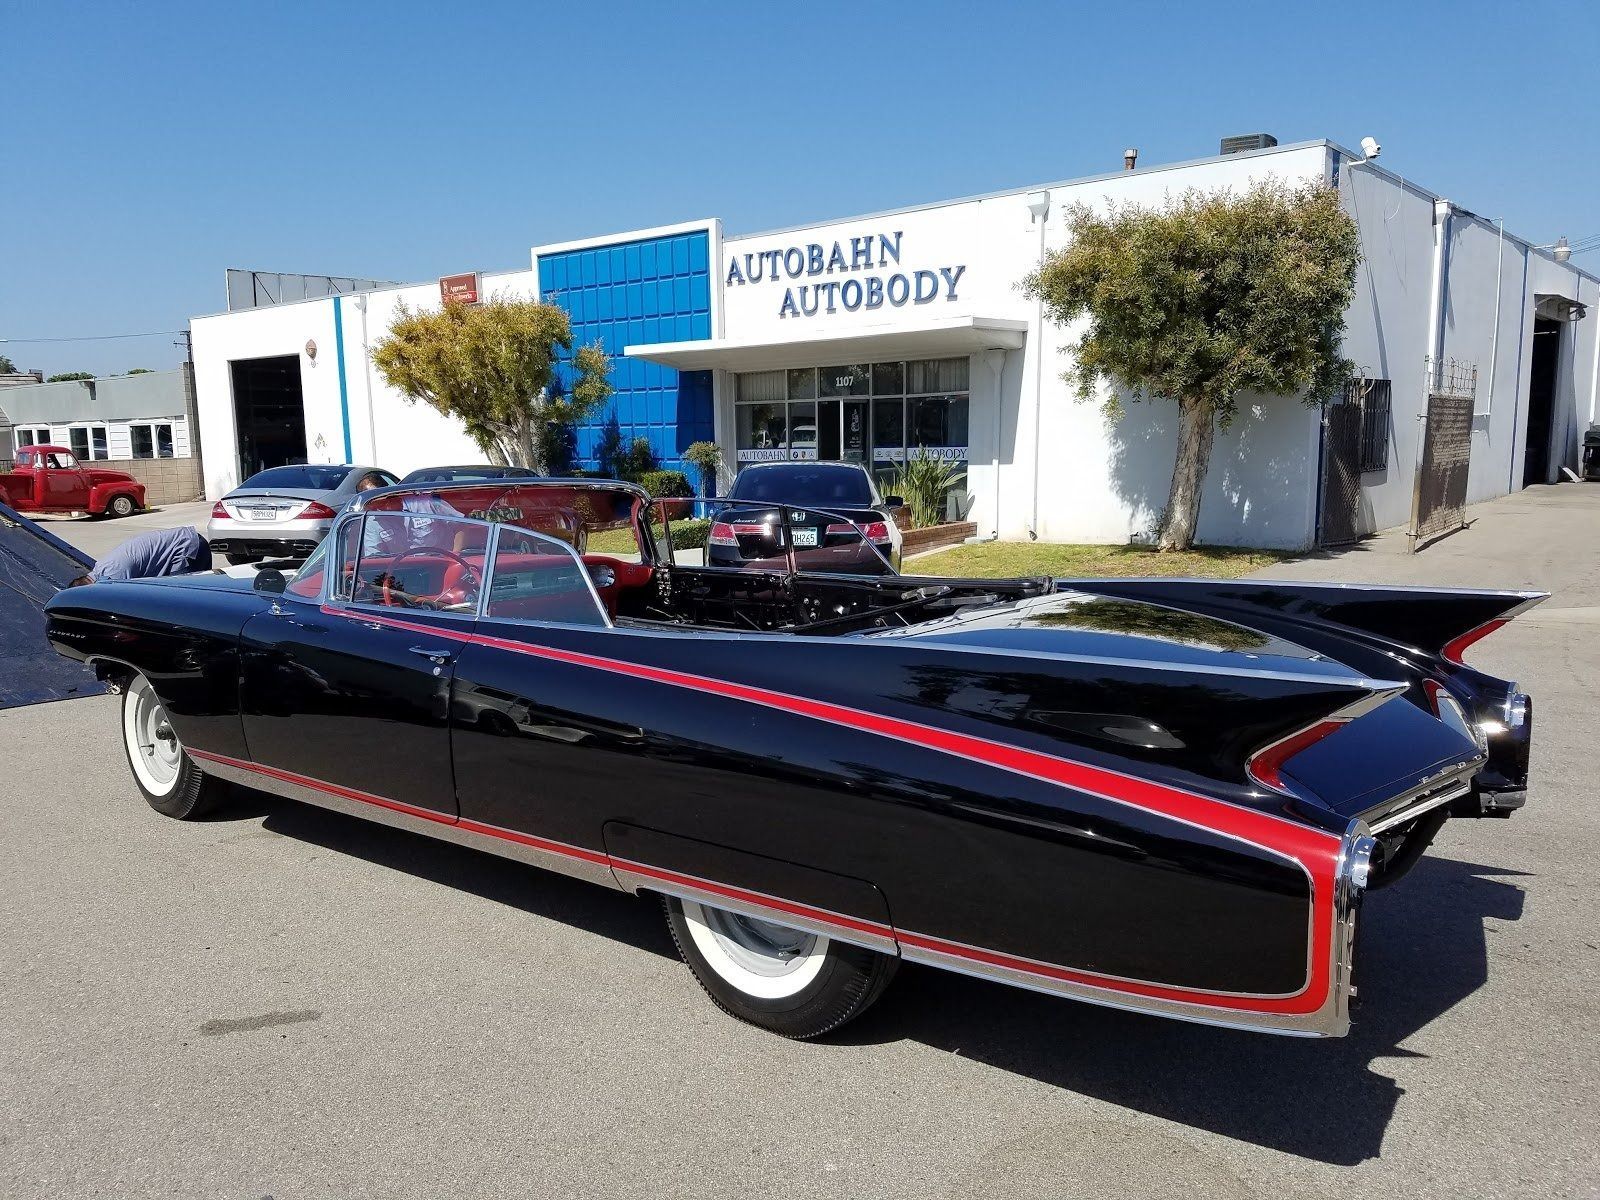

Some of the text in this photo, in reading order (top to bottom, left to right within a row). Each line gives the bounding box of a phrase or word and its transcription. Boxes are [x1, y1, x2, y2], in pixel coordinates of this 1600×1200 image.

[725, 231, 904, 287] AUTOBAHN
[778, 265, 966, 319] AUTOBODY
[835, 376, 854, 387] 1107
[740, 450, 786, 461] AUTOBAHN
[911, 448, 967, 460] ATOBODY
